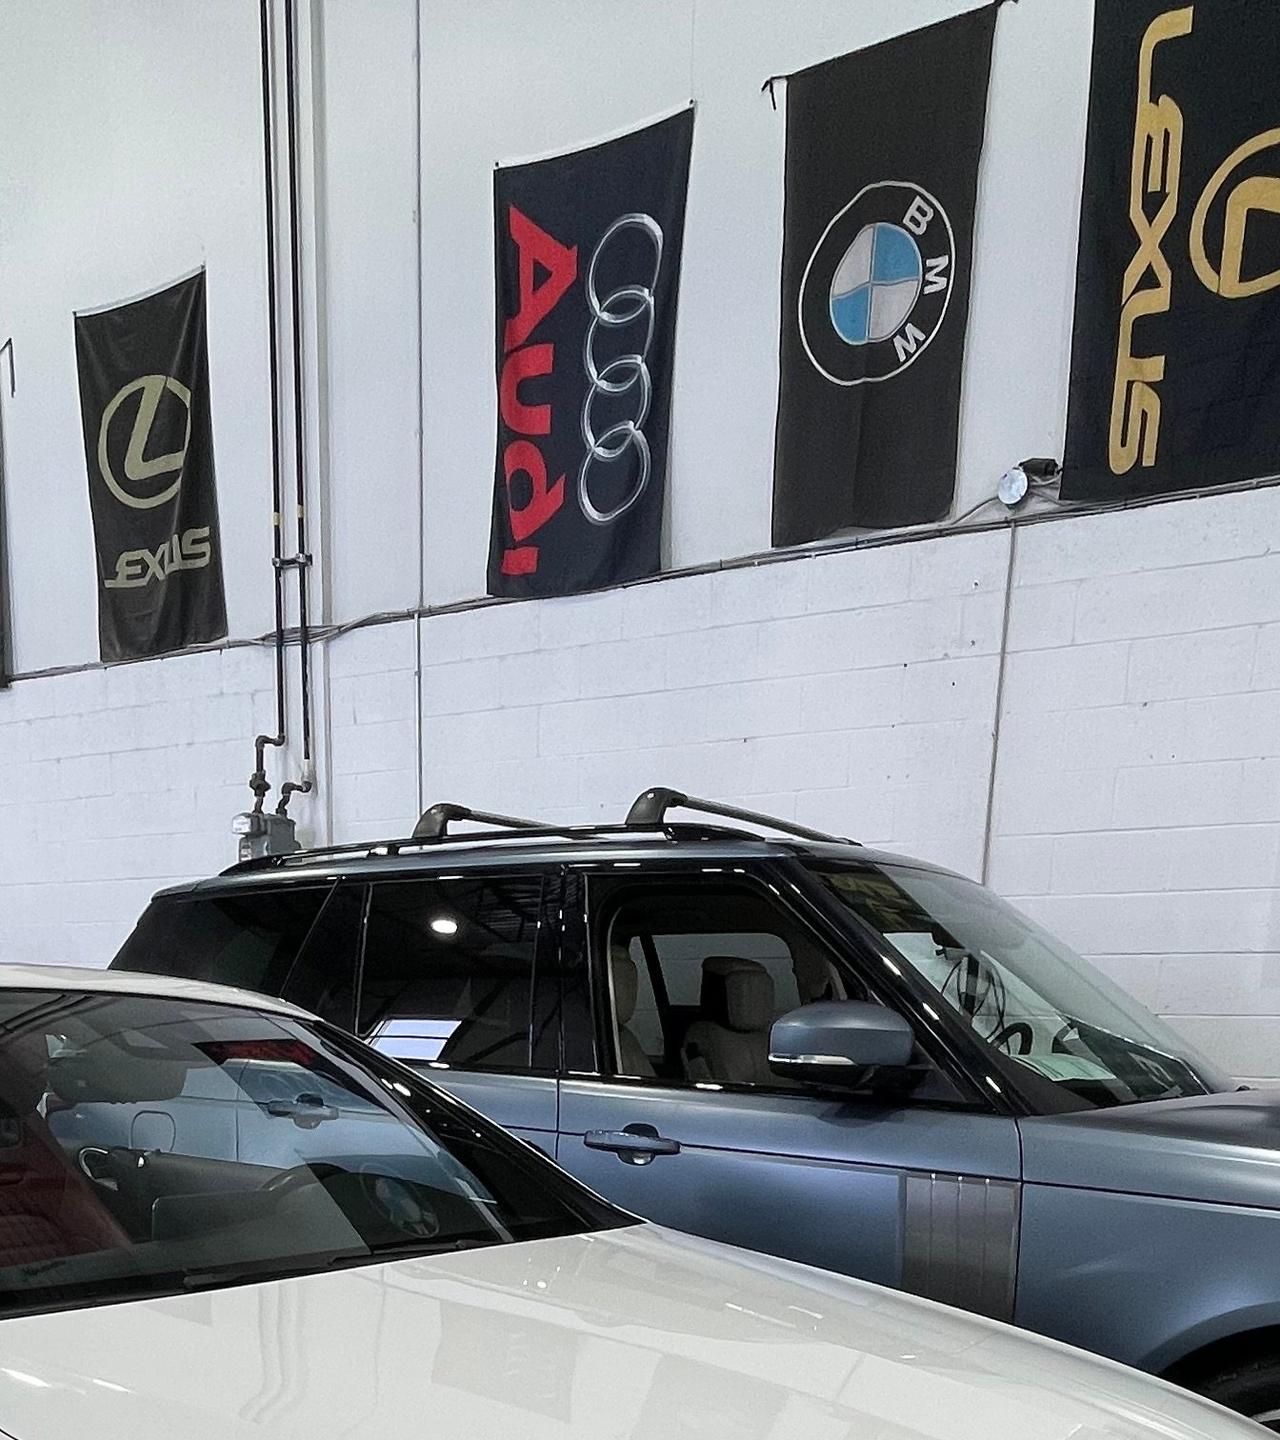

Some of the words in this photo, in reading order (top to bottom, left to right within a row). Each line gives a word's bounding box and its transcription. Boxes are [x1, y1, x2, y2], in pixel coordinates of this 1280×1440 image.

[500, 203, 578, 576] Audi
[892, 196, 950, 363] BMW
[1108, 5, 1194, 476] LEXUS
